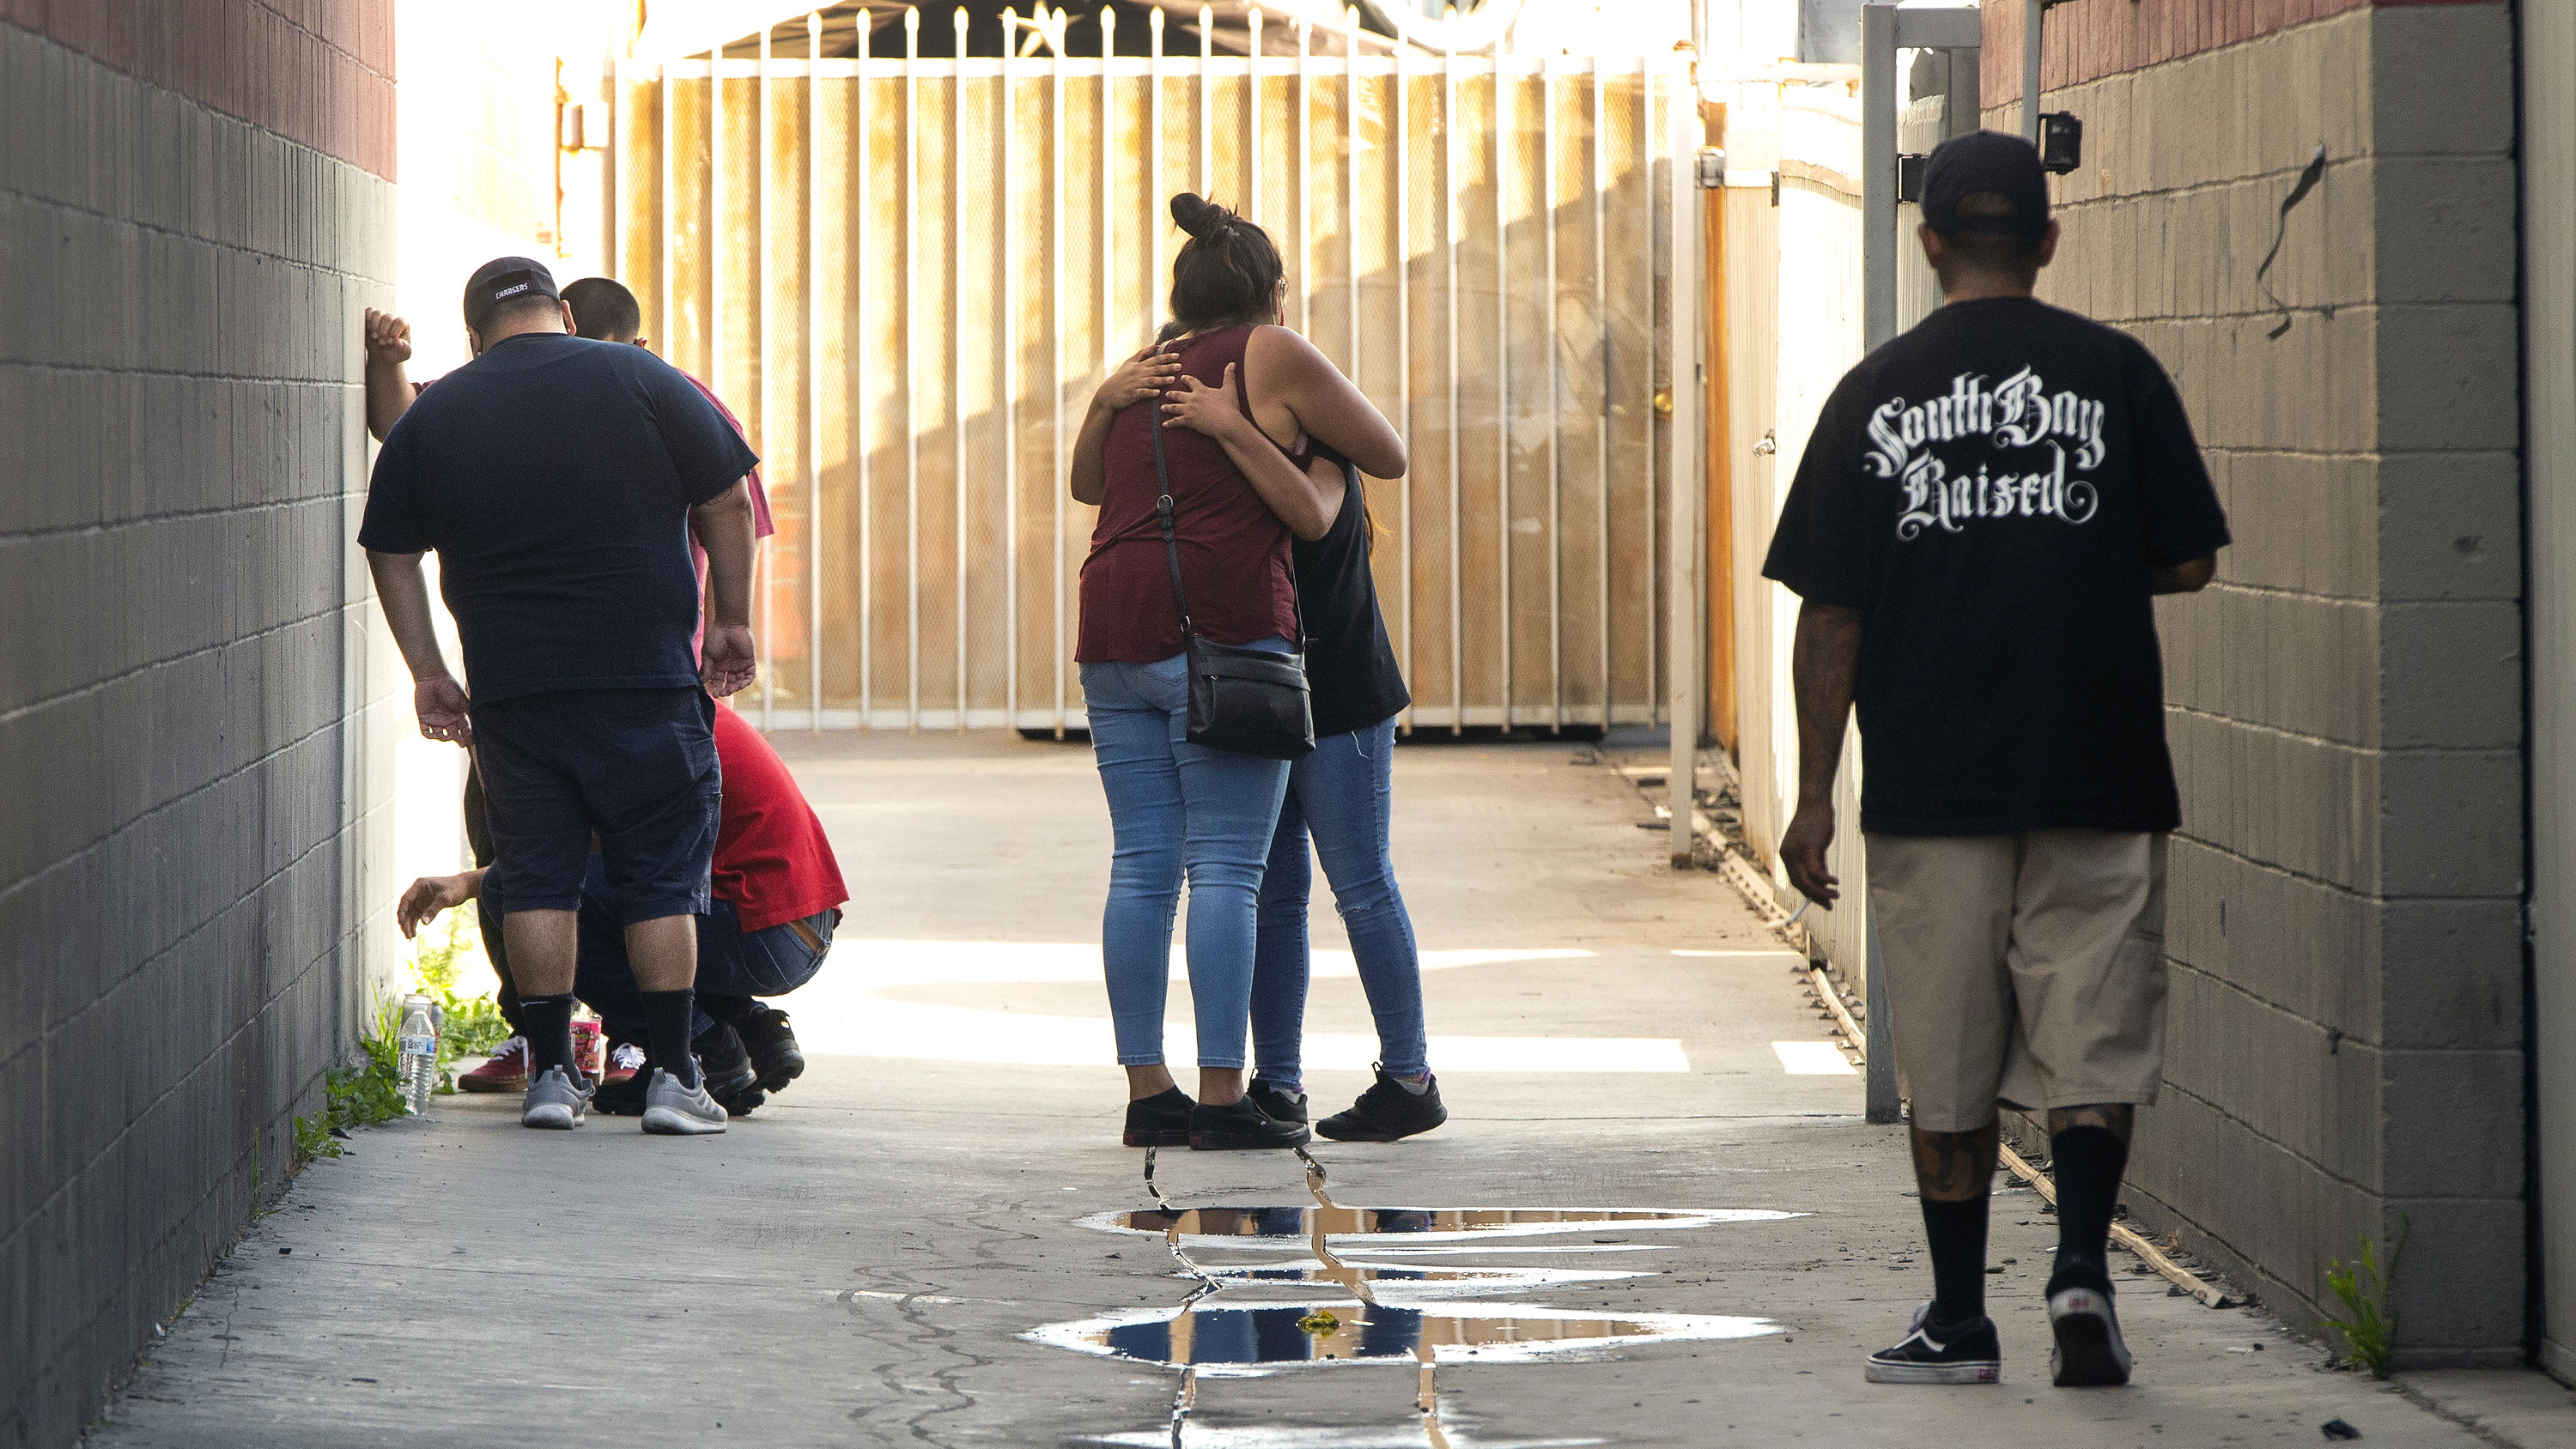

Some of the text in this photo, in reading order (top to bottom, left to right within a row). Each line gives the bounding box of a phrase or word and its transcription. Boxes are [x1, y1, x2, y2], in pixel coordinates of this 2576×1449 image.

[495, 282, 529, 300] CHARGERS
[1862, 364, 2105, 478] South Bay
[1896, 439, 2099, 542] Raised
